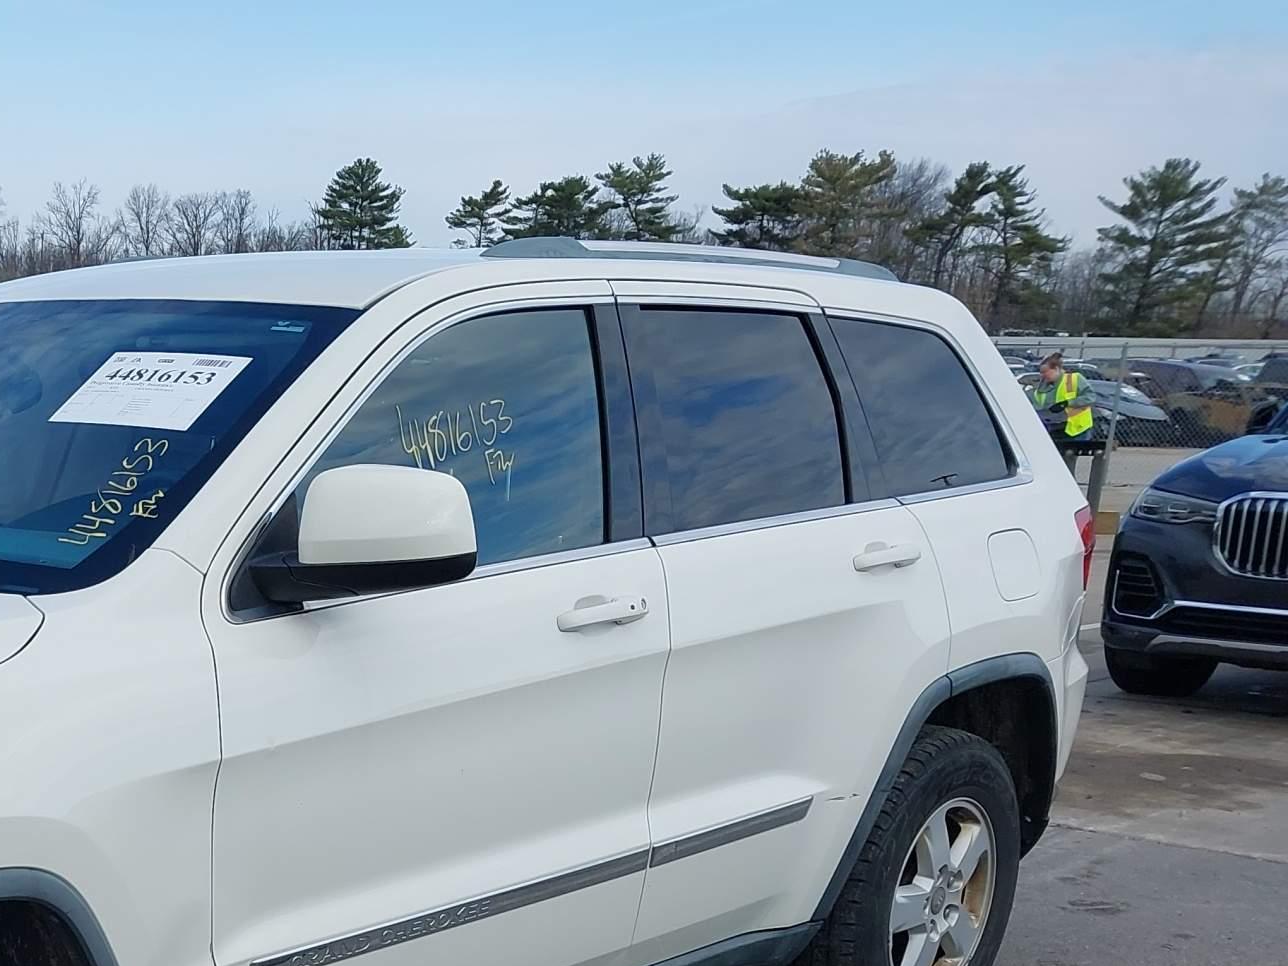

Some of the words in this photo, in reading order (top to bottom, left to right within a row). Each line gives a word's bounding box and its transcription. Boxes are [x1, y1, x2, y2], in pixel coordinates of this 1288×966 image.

[105, 367, 217, 386] 44816153
[396, 399, 513, 470] 44816153
[58, 438, 169, 545] 44816153
[381, 899, 492, 945] CHEROKEE
